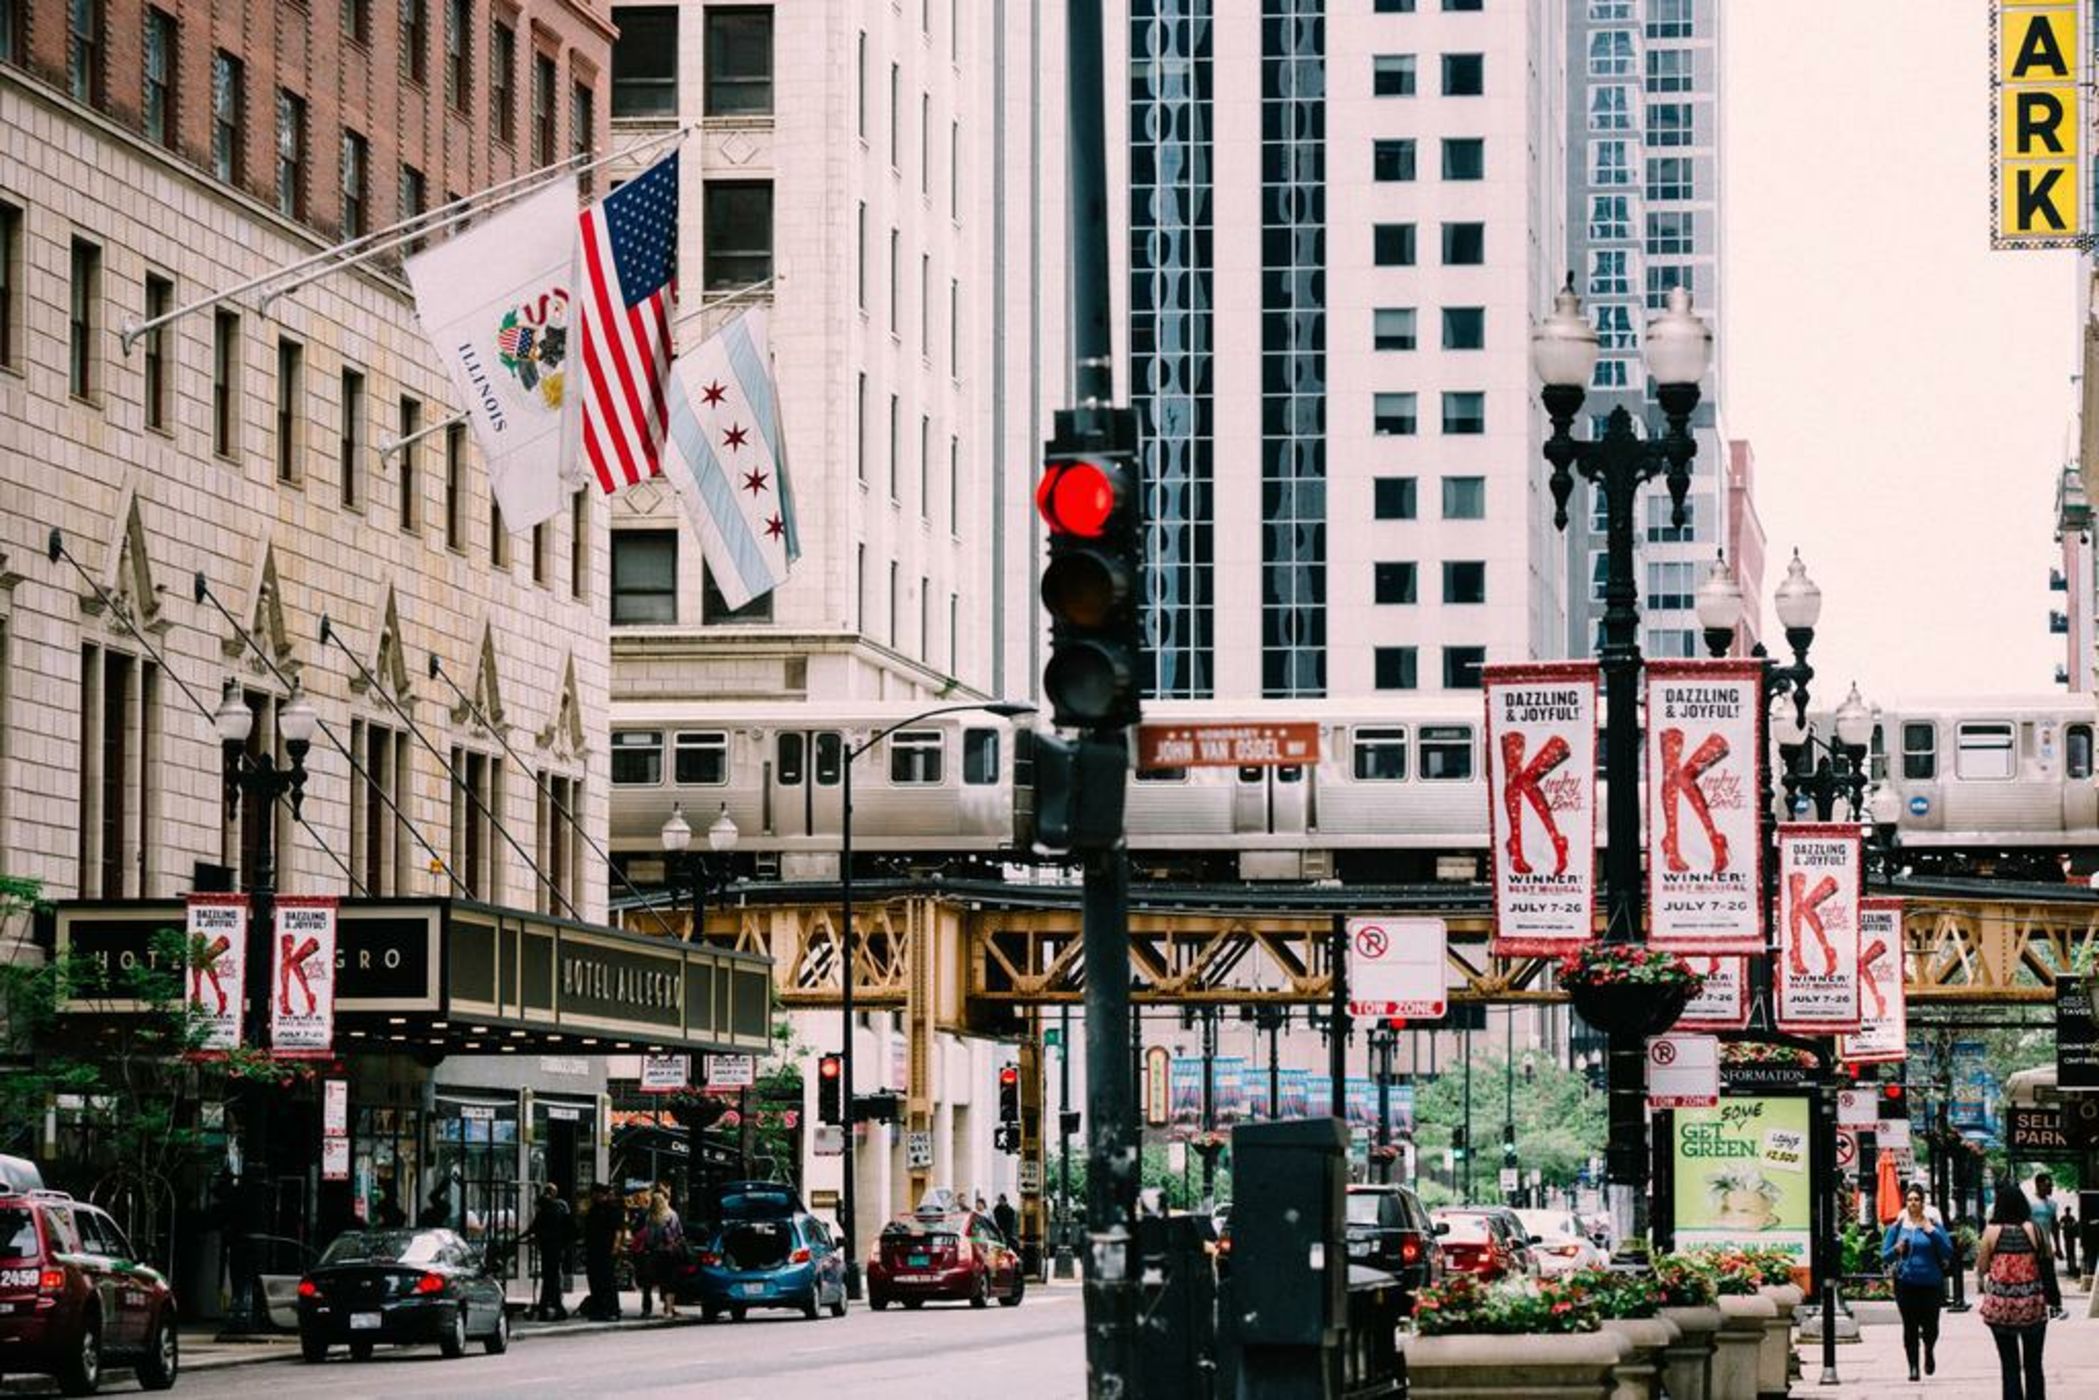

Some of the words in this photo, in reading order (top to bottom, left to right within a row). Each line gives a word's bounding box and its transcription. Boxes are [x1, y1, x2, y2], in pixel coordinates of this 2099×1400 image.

[2011, 15, 2068, 231] ARK
[459, 343, 507, 432] ILLINOIS
[1505, 690, 1579, 707] DAZZLING
[1665, 688, 1739, 703] DAZZLING
[1505, 709, 1516, 722] &
[1520, 706, 1579, 722] JOYFUL!
[1665, 704, 1676, 718] &
[1680, 704, 1740, 718] JOYFUL!
[1793, 844, 1846, 856] DAZZLING
[1803, 856, 1847, 866] JOYFUL!
[1509, 903, 1547, 913] JULY
[1551, 903, 1582, 913] 7-26
[1663, 901, 1706, 911] JULY
[1711, 901, 1748, 911] 7-26
[196, 910, 237, 920] DAZZLING
[285, 912, 327, 922] DAZZLING
[564, 958, 610, 1000] HOTEL
[616, 966, 681, 1009] ALLEGRO
[1789, 995, 1820, 1003] JULY
[1356, 1001, 1387, 1015] TOW
[1398, 1001, 1434, 1015] ZONE
[2063, 1008, 2092, 1016] TAVER
[1720, 1069, 1806, 1081] NFORMATION
[1721, 1102, 1764, 1121] SOME
[1680, 1122, 1725, 1140] GET
[2014, 1130, 2067, 1146] PARK
[1680, 1140, 1759, 1157] GREEN.
